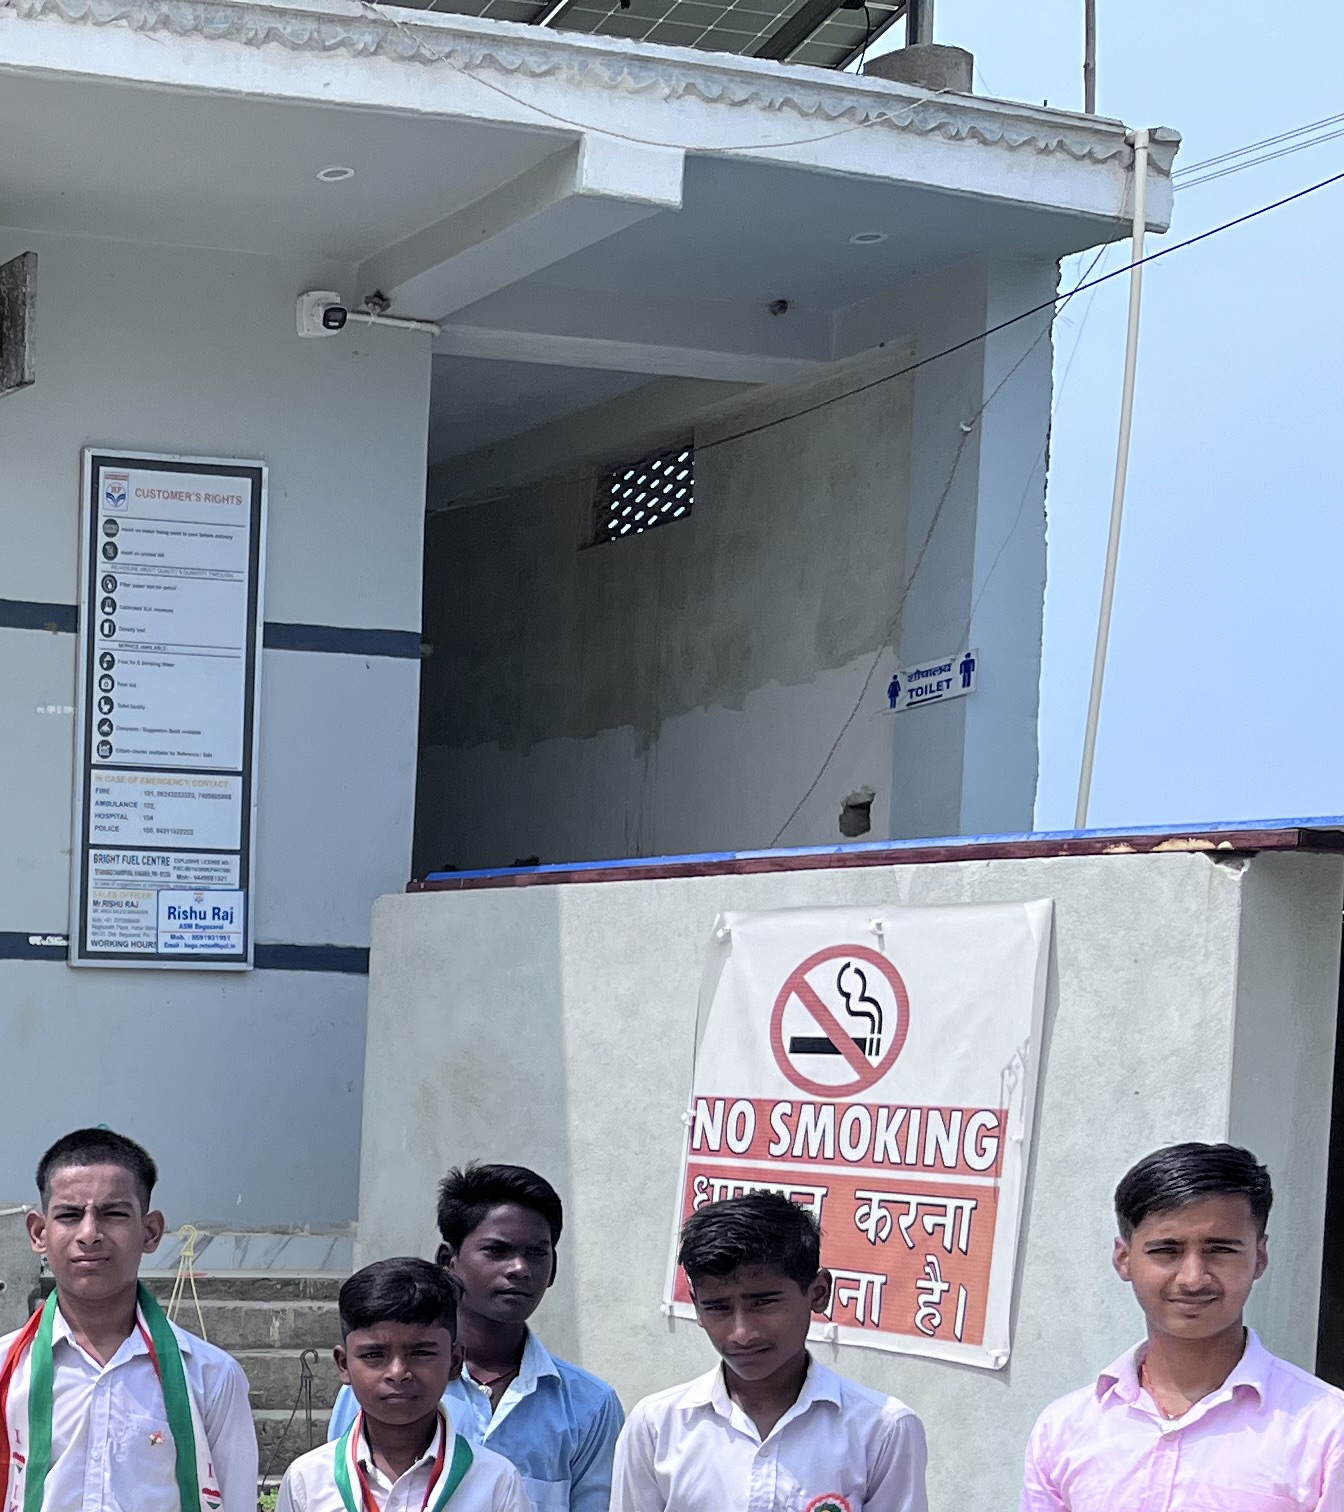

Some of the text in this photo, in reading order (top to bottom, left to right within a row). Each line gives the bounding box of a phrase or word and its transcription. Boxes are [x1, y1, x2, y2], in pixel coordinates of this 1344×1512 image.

[135, 488, 242, 505] CUSTOMER'S RIGHTS
[908, 678, 952, 699] TOILET
[105, 776, 125, 784] CASE
[94, 854, 170, 866] BRIGHT FUEL CENTRE
[168, 906, 234, 924] Rishu Raj
[91, 940, 128, 948] WORKING
[691, 1098, 1001, 1172] NO SMOKING
[854, 1189, 978, 1254] करना
